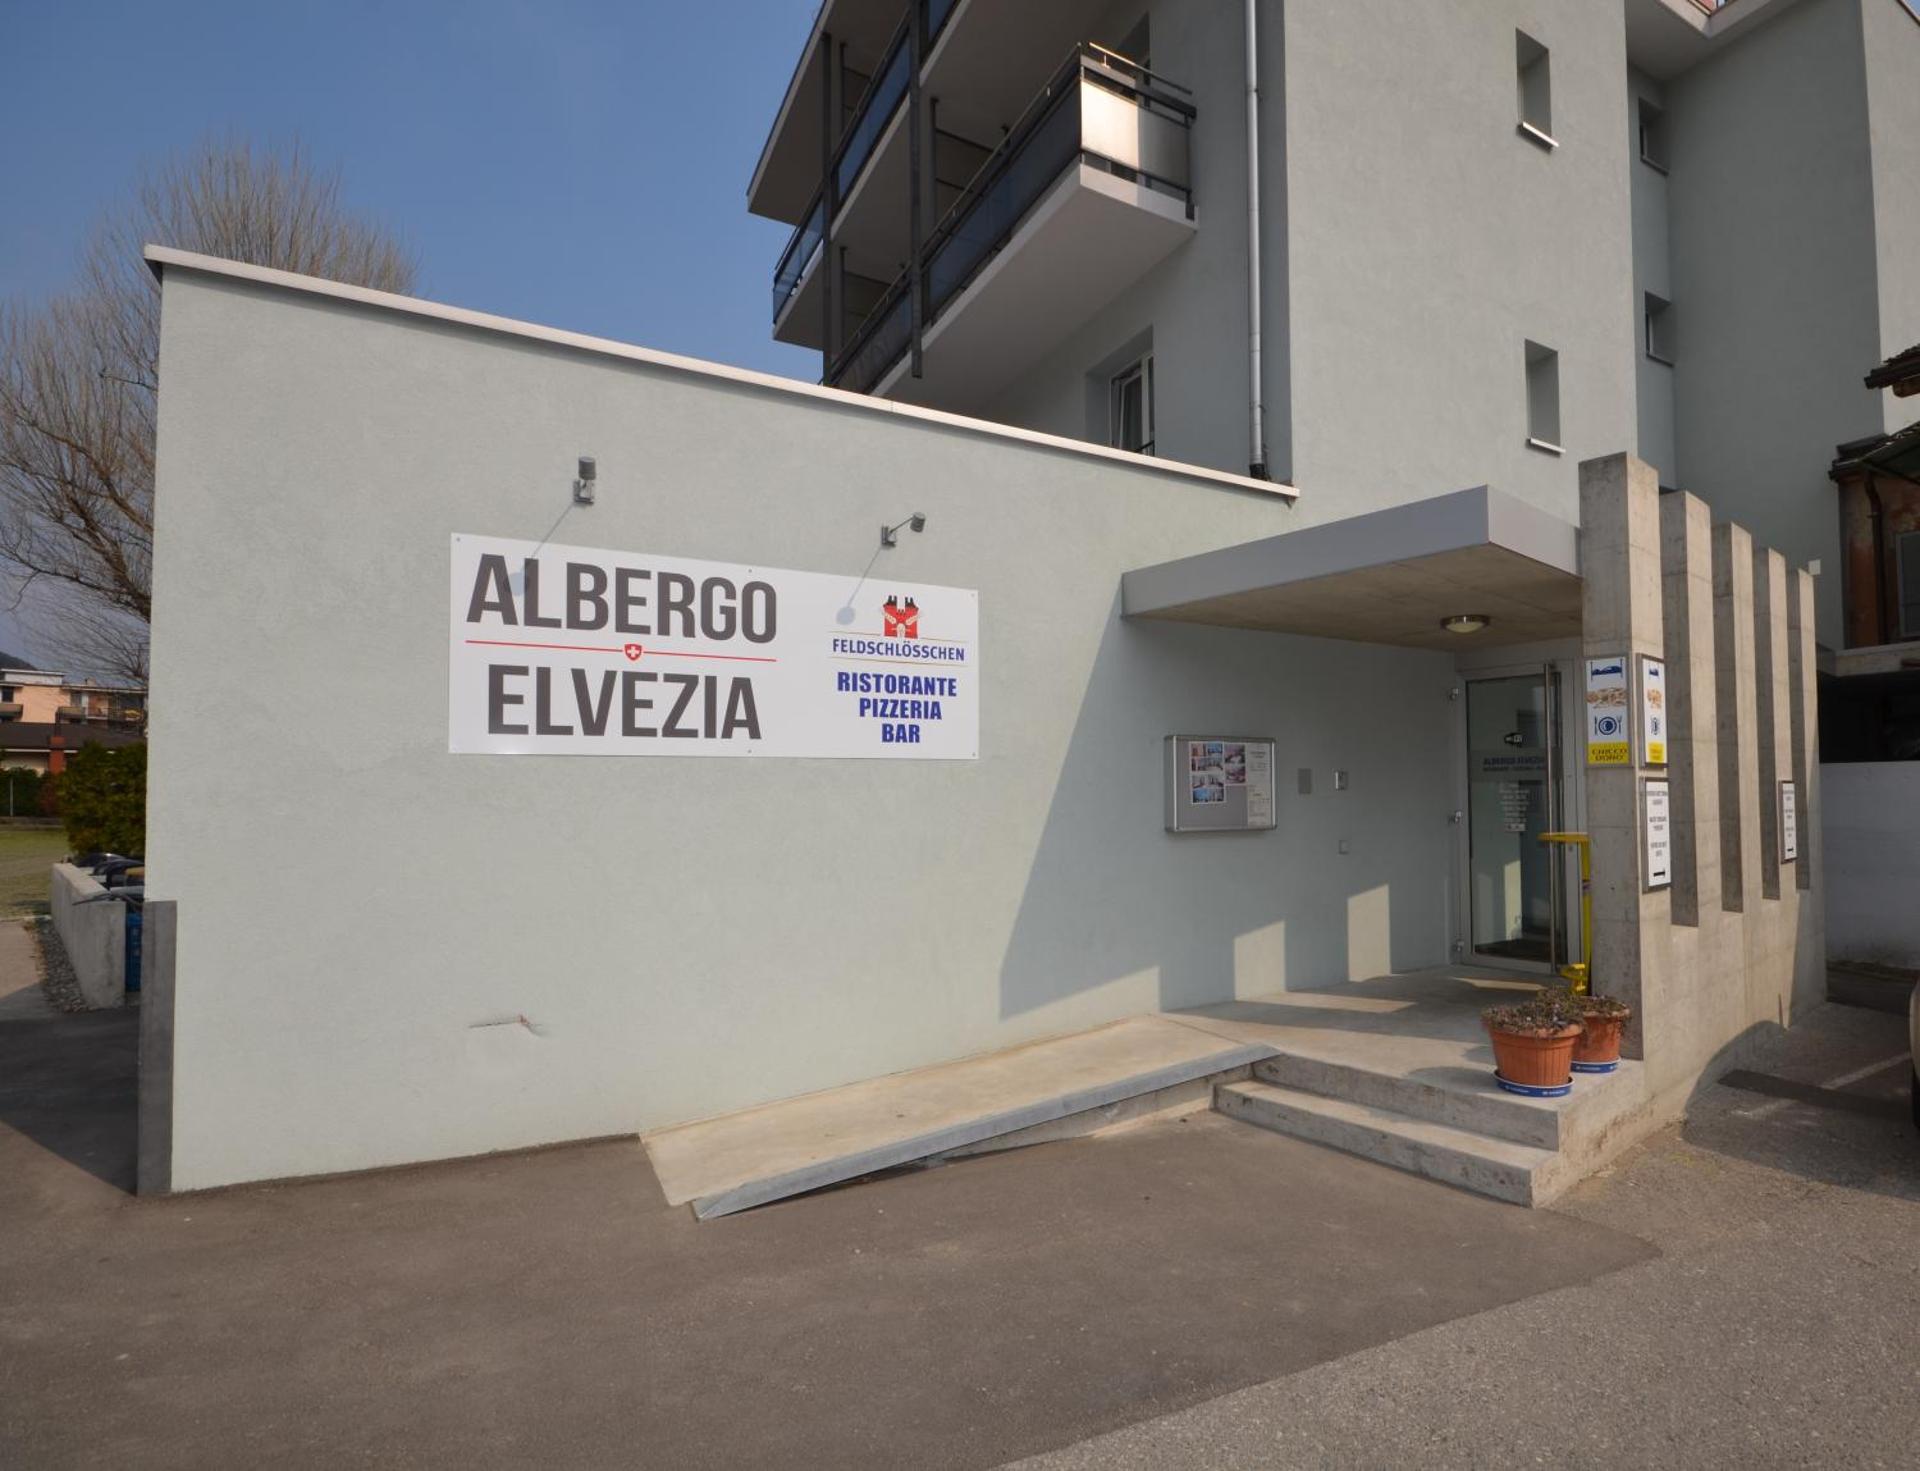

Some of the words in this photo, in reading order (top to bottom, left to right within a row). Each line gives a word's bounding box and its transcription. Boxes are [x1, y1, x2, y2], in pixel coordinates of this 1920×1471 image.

[465, 553, 777, 643] ALBERGO
[832, 636, 965, 661] FELDSCHLÖSSCHEN
[837, 671, 957, 697] RISTORANTE
[488, 663, 762, 740] ELVEZIA
[858, 698, 943, 719] PIZZERIA
[881, 722, 921, 743] BAR
